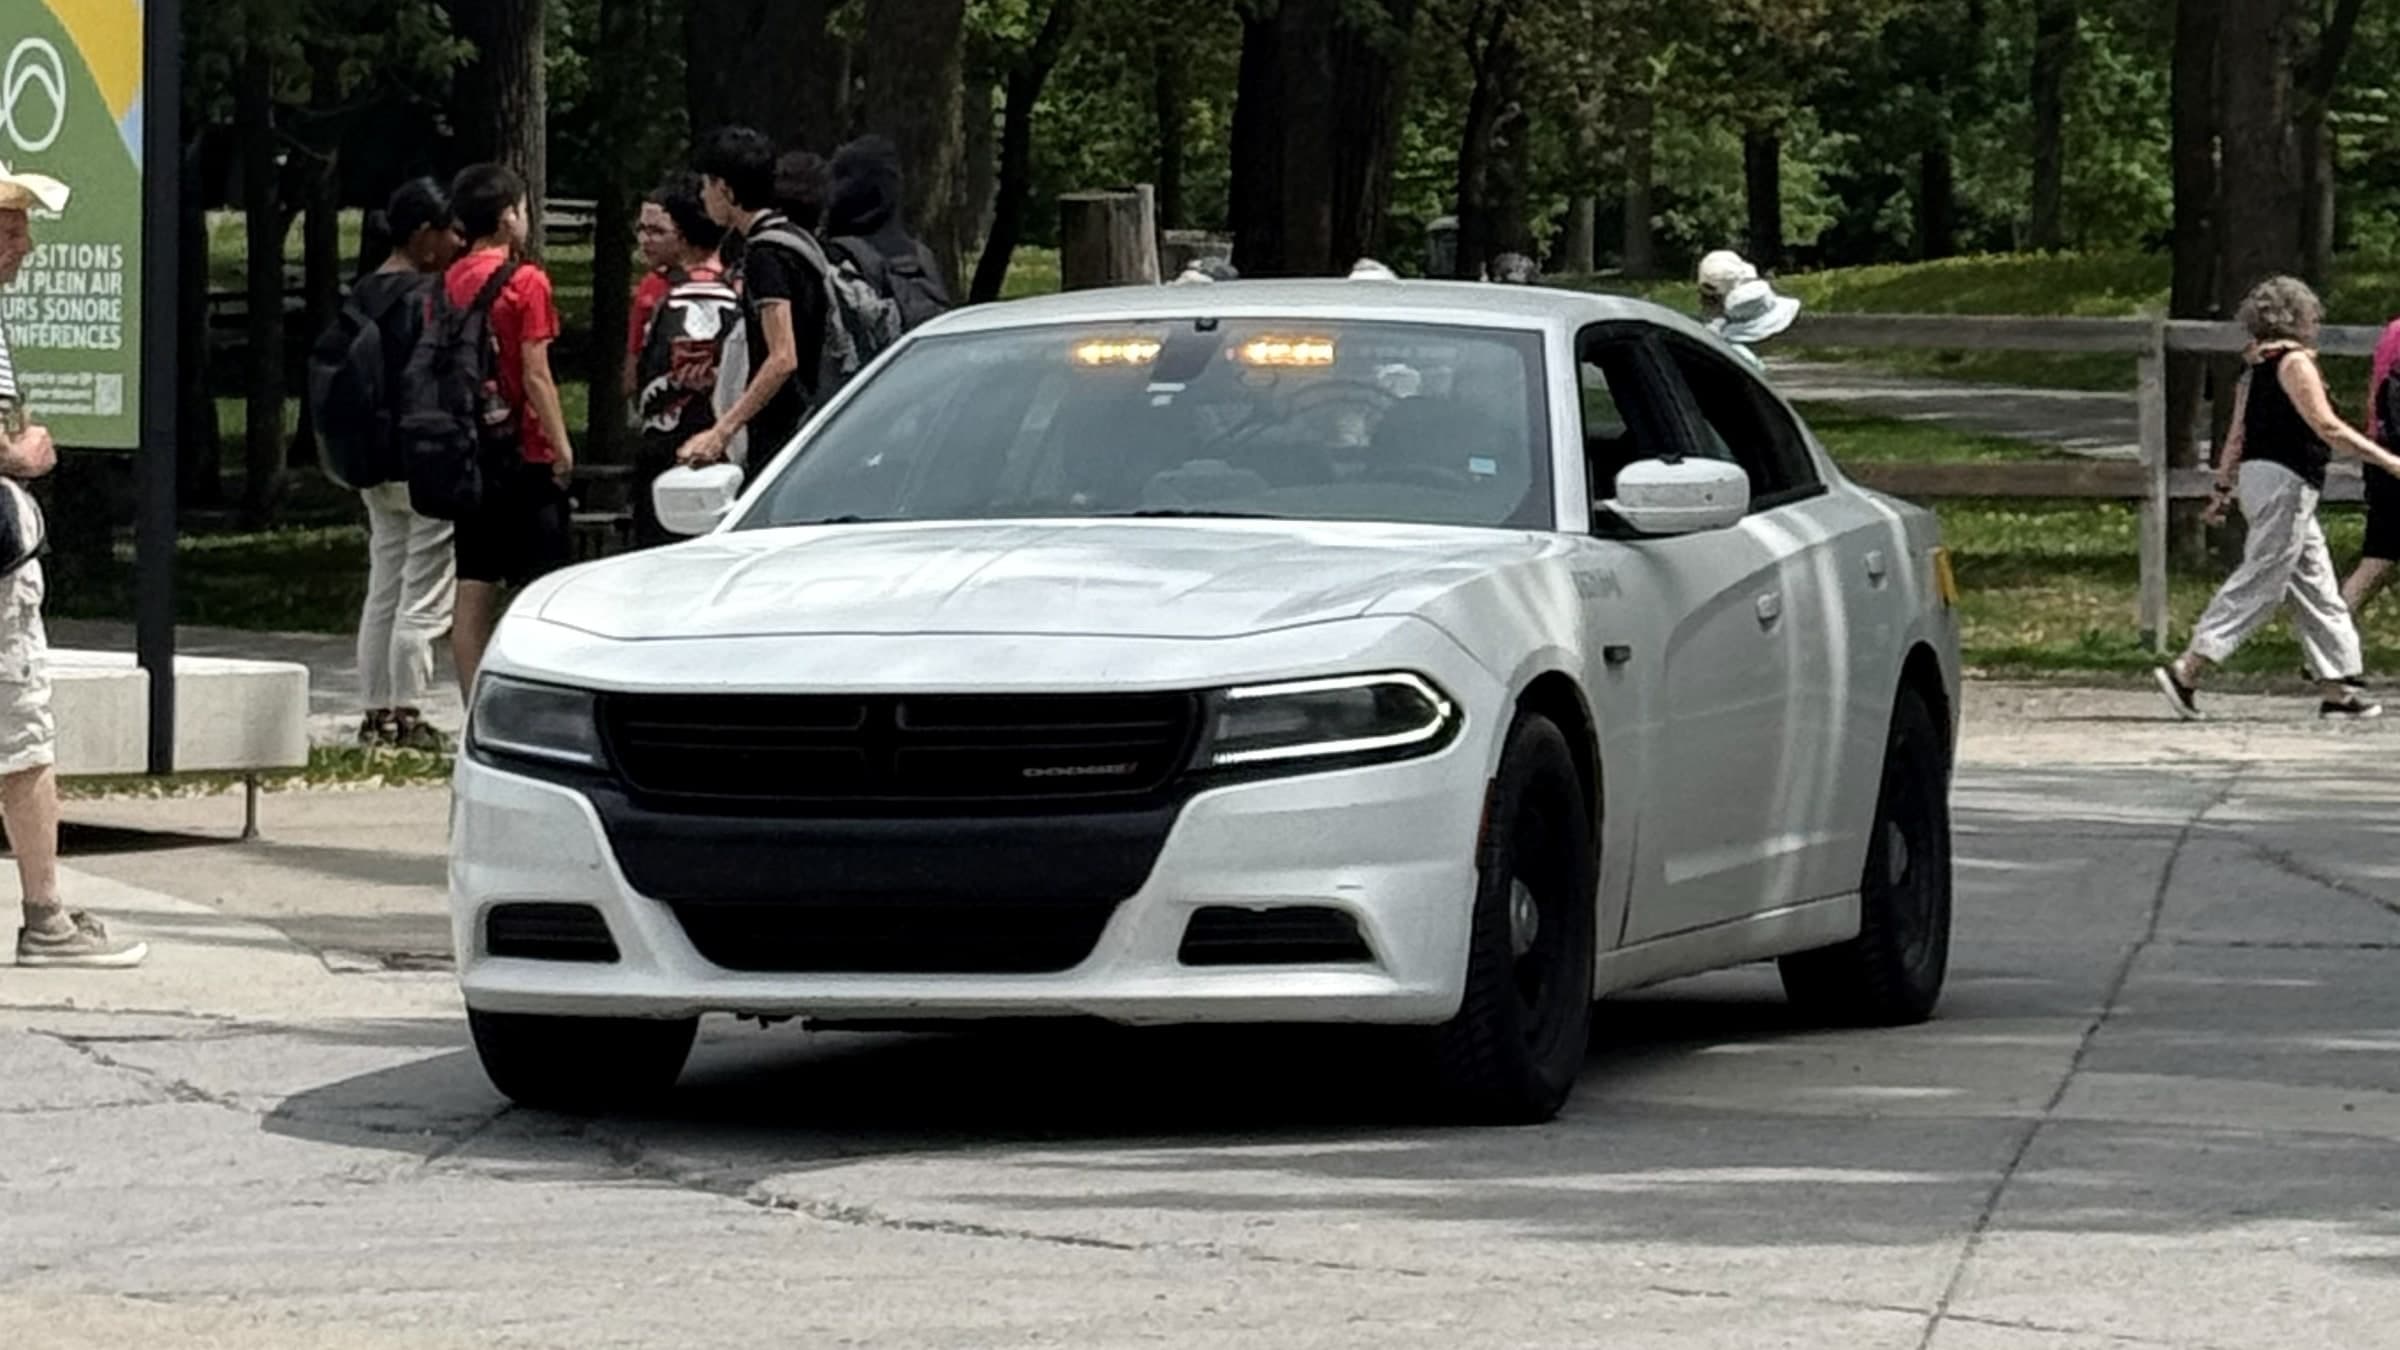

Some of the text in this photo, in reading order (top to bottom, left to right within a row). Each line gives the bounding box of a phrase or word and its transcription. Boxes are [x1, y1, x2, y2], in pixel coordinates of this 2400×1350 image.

[33, 270, 86, 294] PLEIN
[90, 271, 122, 295] AIR
[43, 298, 122, 323] SONORE
